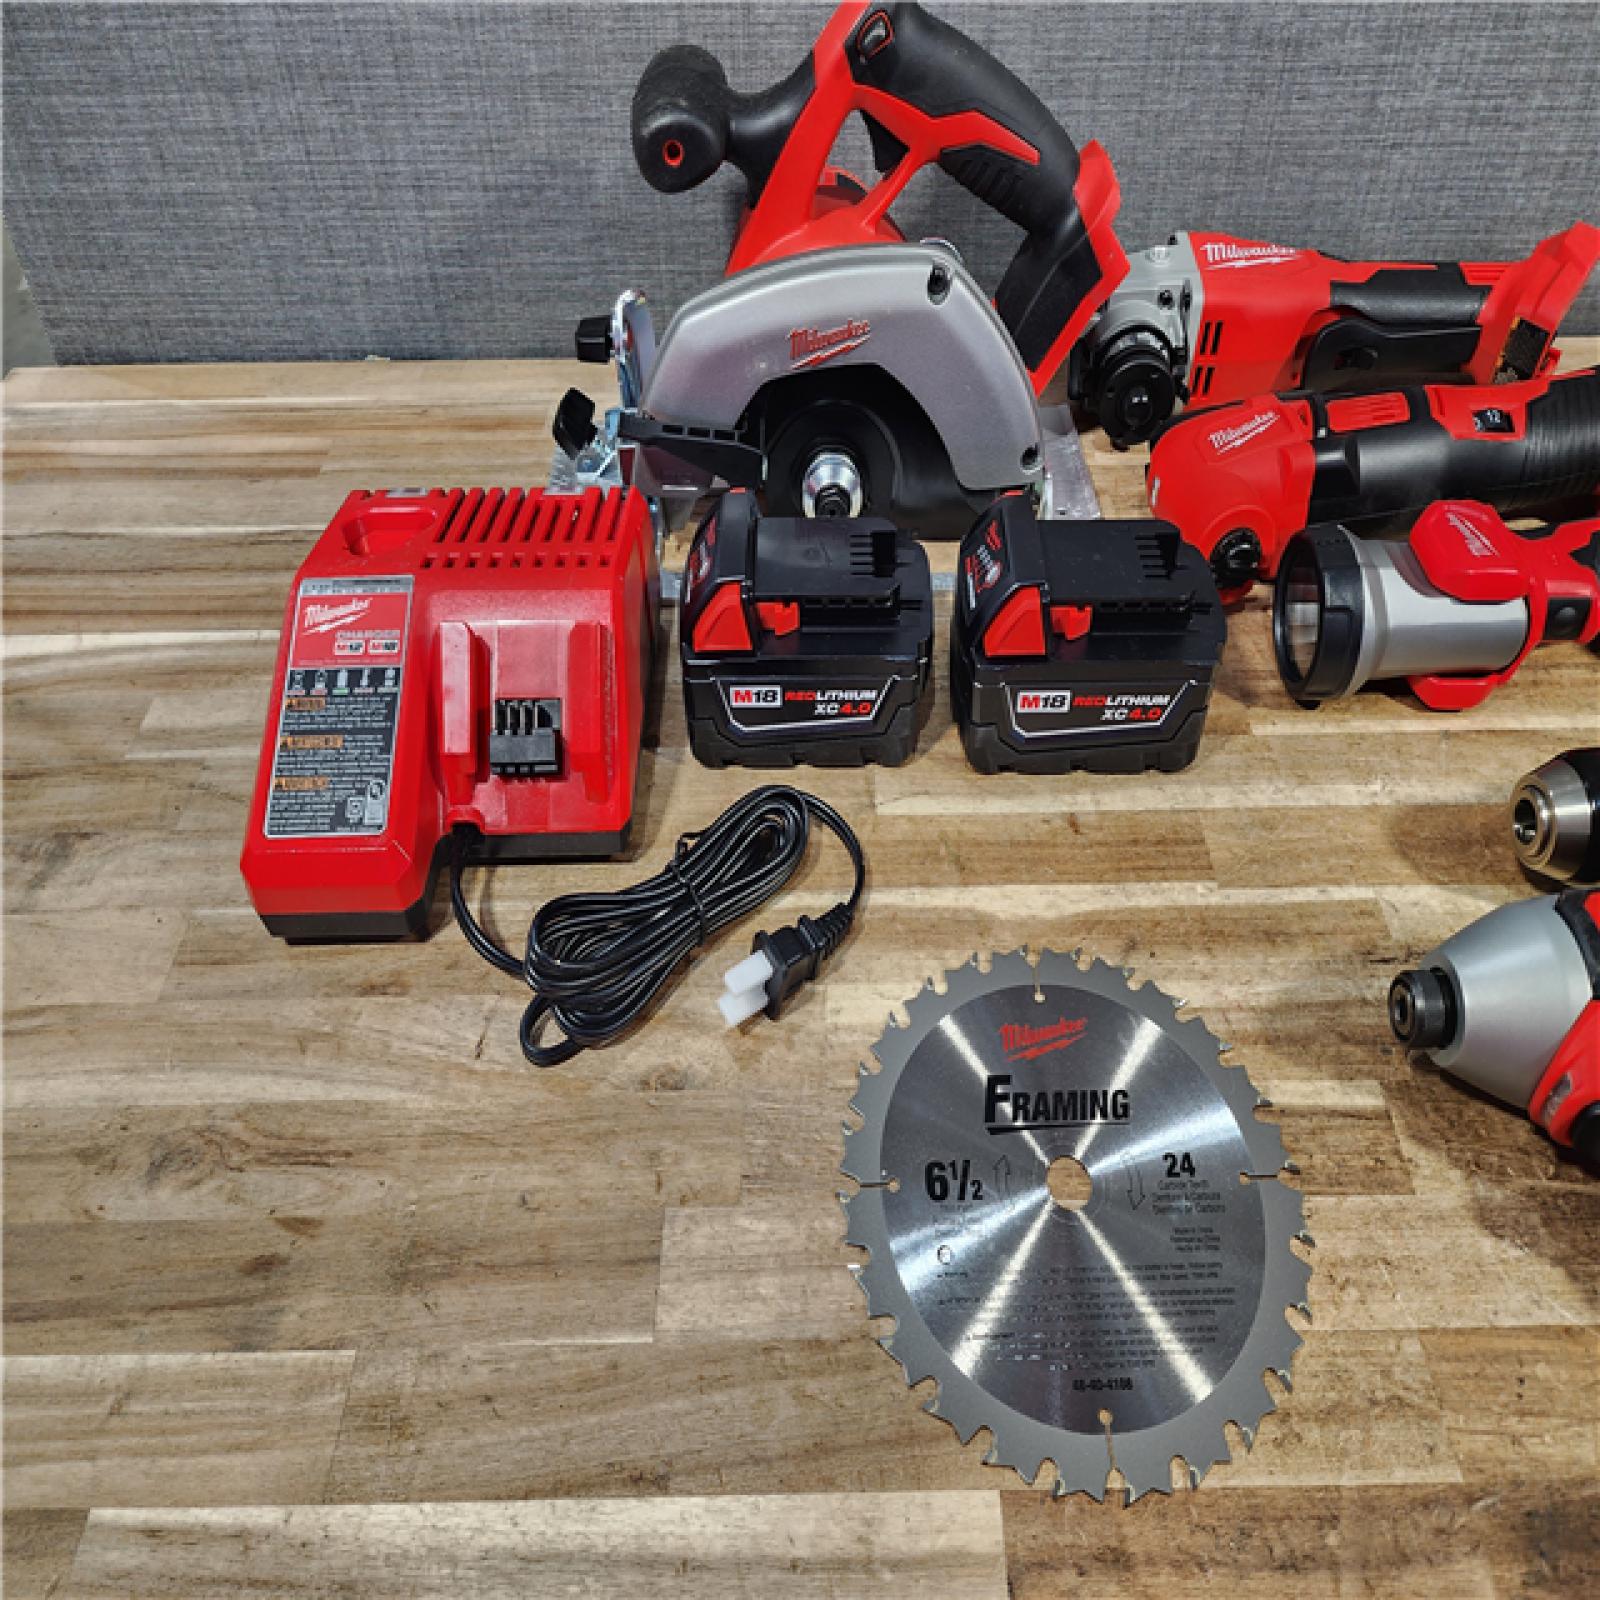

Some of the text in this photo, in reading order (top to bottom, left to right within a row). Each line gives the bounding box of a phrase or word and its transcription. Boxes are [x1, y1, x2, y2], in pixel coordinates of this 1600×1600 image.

[1200, 242, 1297, 262] Milwaukee
[786, 318, 870, 359] Milwaukee
[1208, 410, 1277, 448] Milwaukee
[1486, 408, 1501, 424] 12
[733, 688, 779, 704] M18
[1019, 694, 1067, 709] M18
[998, 1016, 1089, 1053] Milwaukee
[984, 1074, 1131, 1123] FRAMING
[1162, 1151, 1196, 1179] 24
